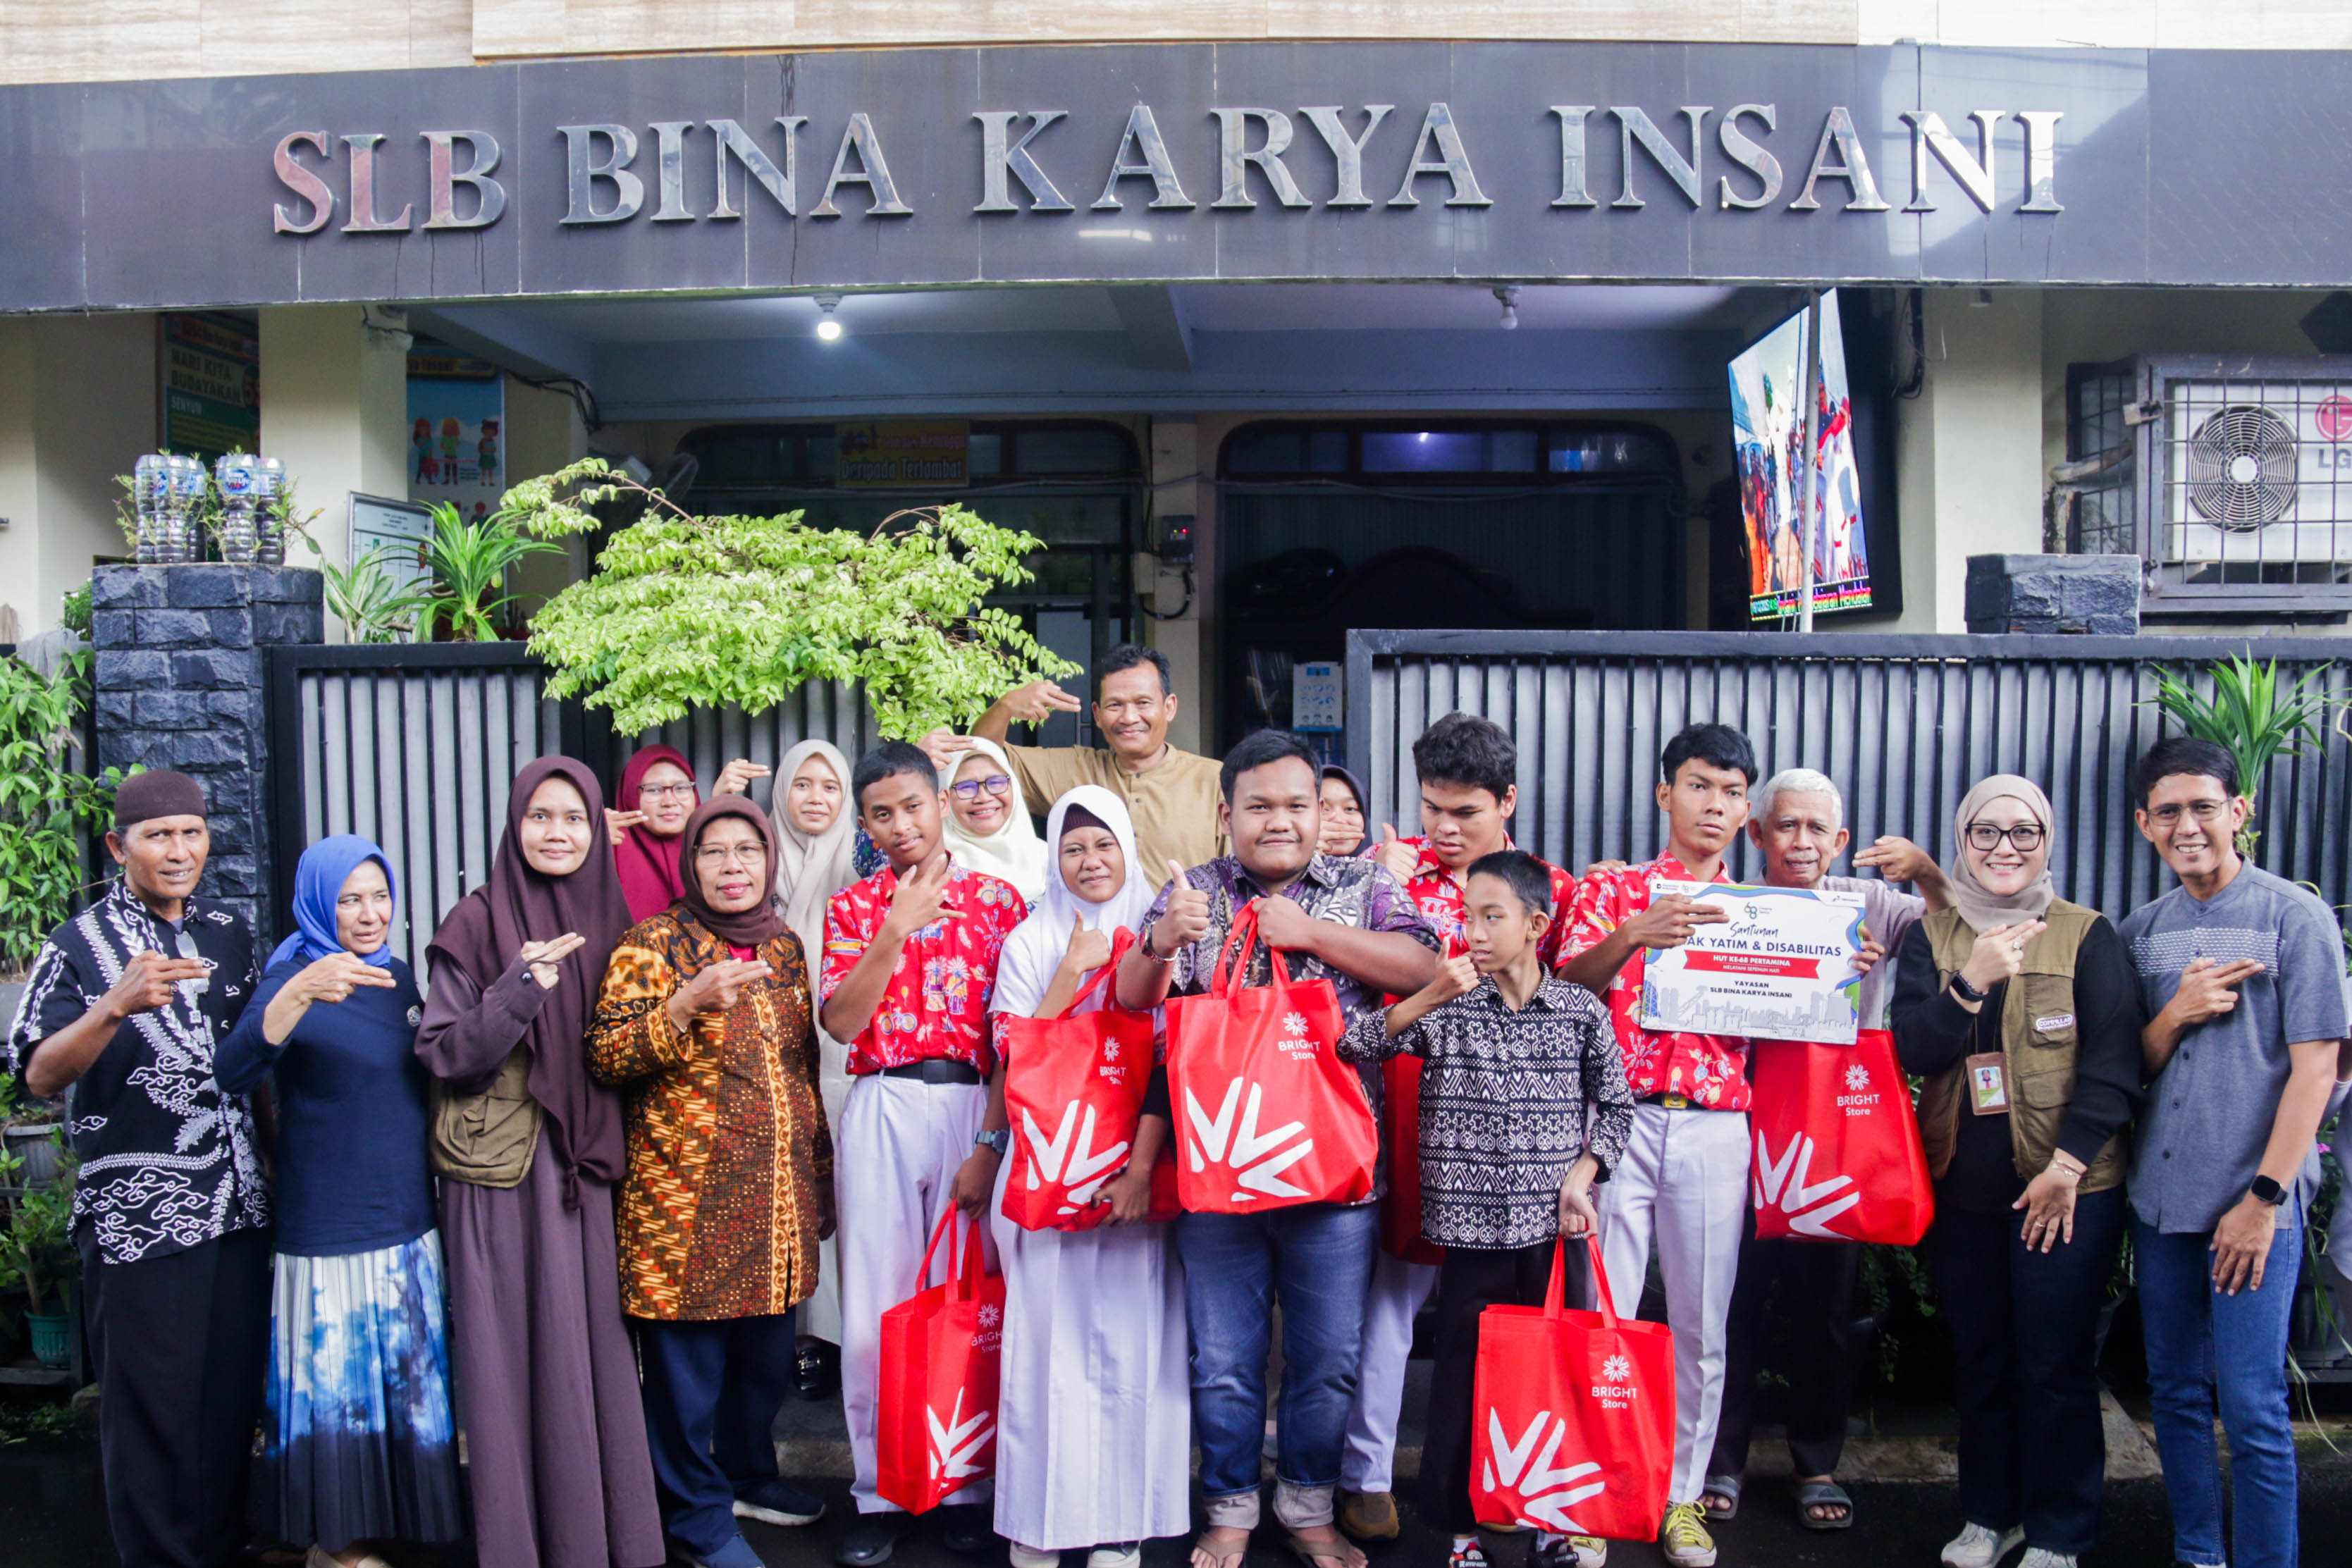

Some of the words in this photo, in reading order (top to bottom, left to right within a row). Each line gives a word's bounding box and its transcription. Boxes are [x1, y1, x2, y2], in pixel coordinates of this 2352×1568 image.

[272, 129, 509, 235] SLB
[555, 112, 915, 225] BINA
[971, 102, 1494, 212] KARYA
[1548, 103, 2066, 214] INSANI
[2317, 448, 2352, 469] LG
[899, 457, 963, 480] Terlambat
[1730, 921, 1779, 938] Santunan
[1687, 936, 1705, 947] AK
[1710, 938, 1748, 949] YATIM
[1752, 941, 1761, 951] &
[1766, 942, 1842, 956] DISABILITAS
[1750, 958, 1791, 966] PERTAMINA
[1278, 1039, 1320, 1051] BRIGHT
[1837, 1094, 1880, 1106] BRIGHT
[1845, 1107, 1871, 1116] Store
[971, 1331, 1002, 1346] BRIGH
[1591, 1386, 1637, 1399] BRIGHT
[1601, 1399, 1627, 1409] Store
